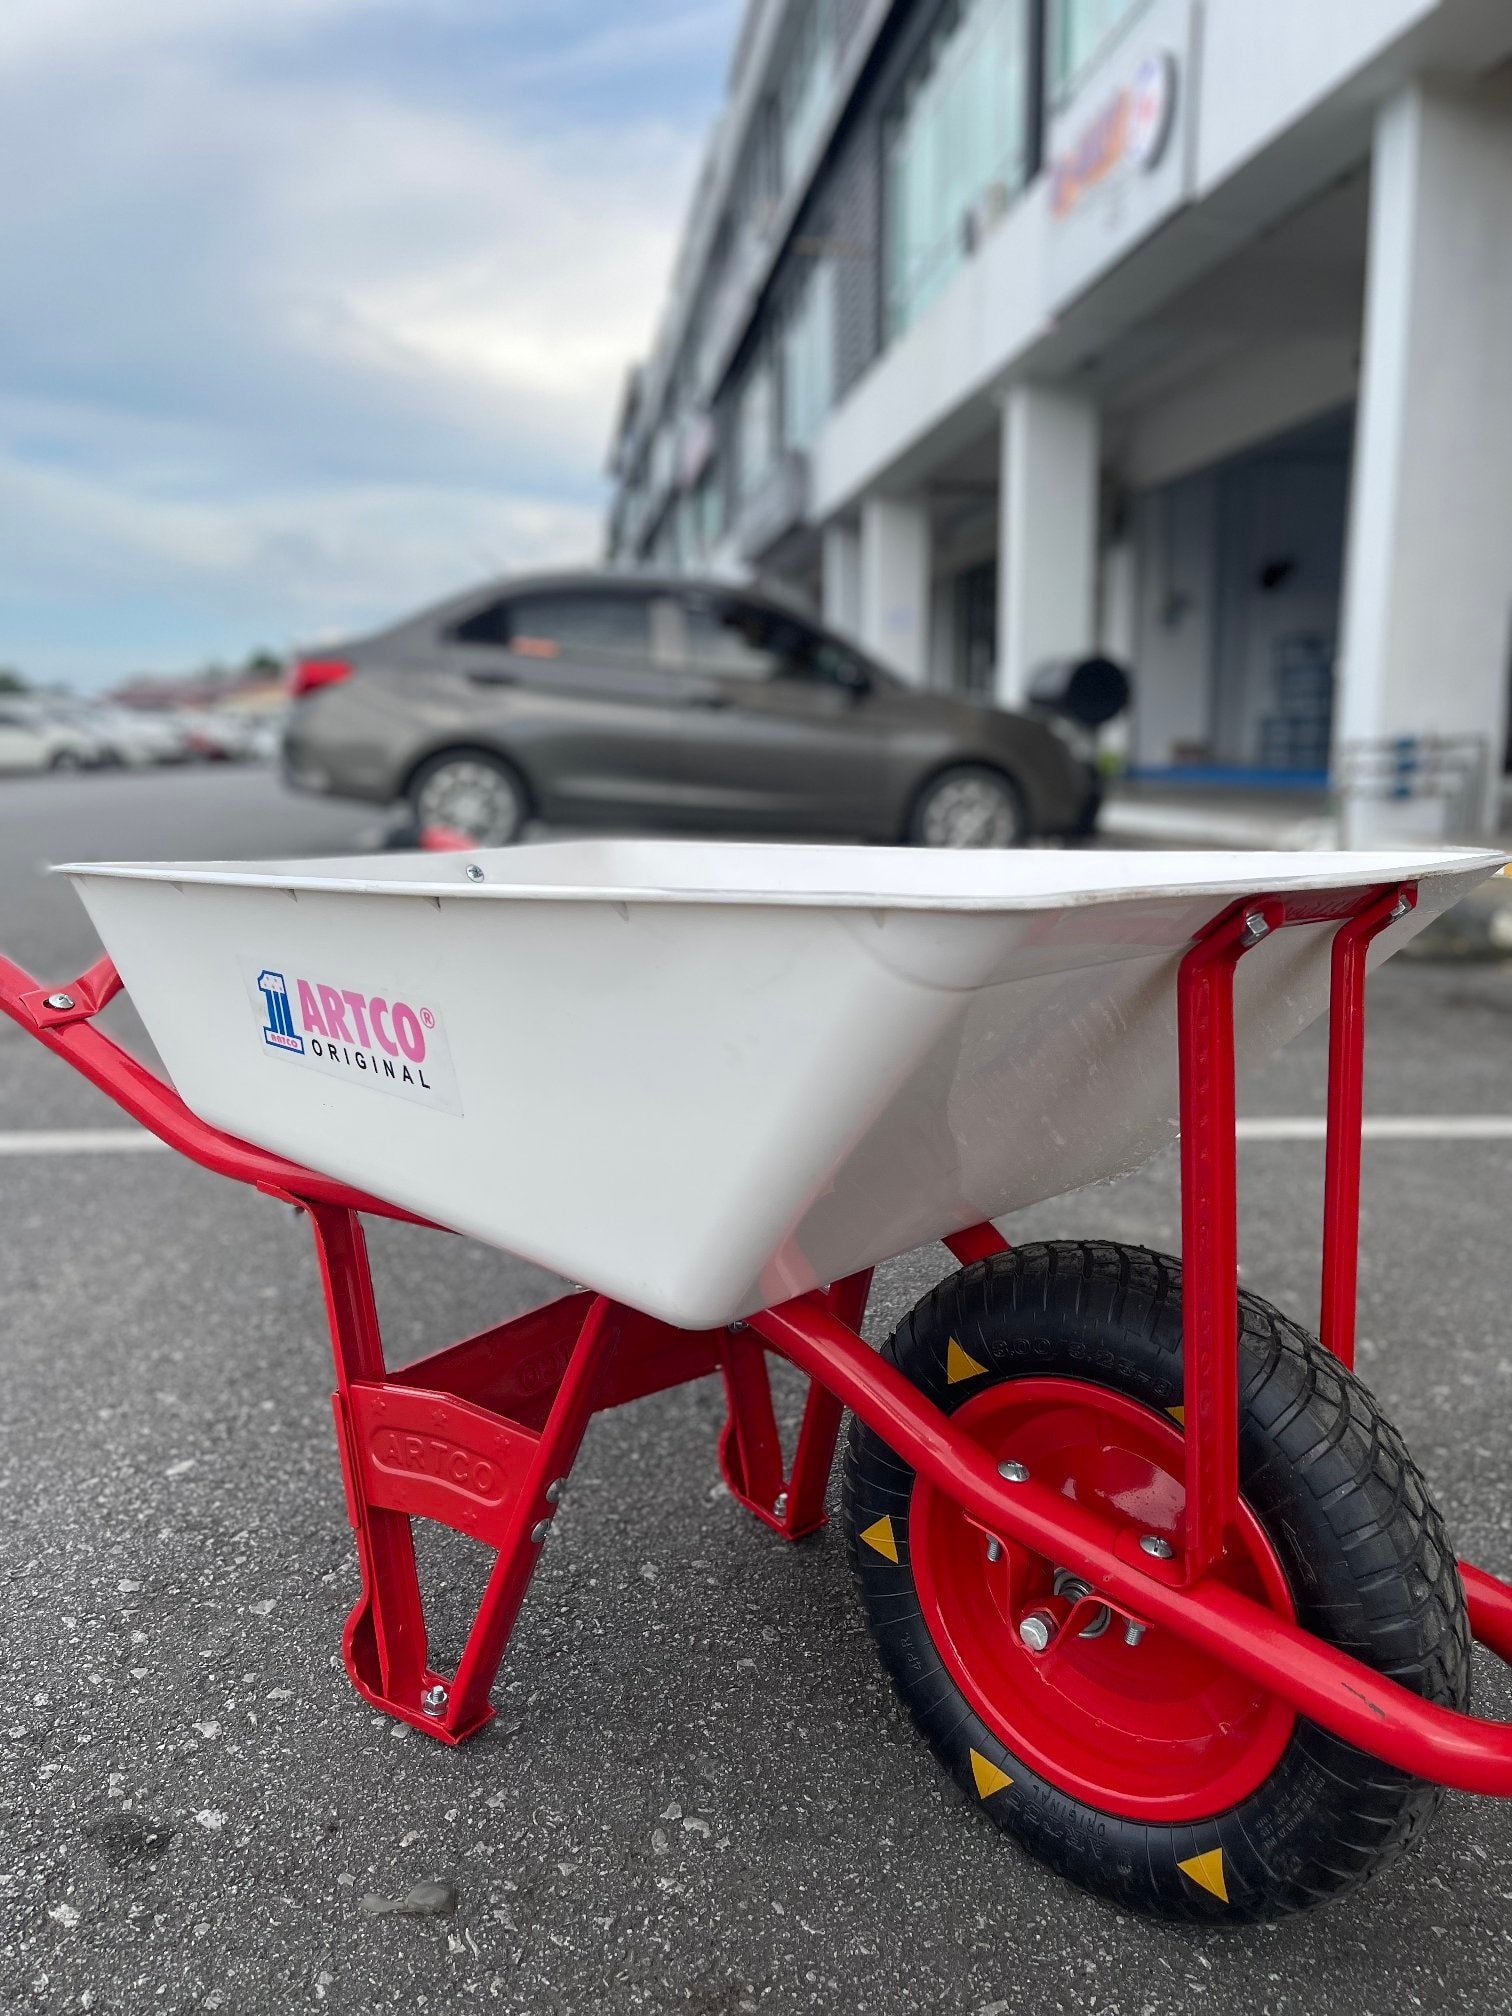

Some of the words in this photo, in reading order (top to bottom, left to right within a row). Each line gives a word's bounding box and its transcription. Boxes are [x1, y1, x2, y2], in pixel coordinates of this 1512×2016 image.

[311, 1039, 431, 1089] ORIGINAL
[382, 1433, 495, 1490] ARTCO
[1032, 1784, 1107, 1838] ORIGINAL
